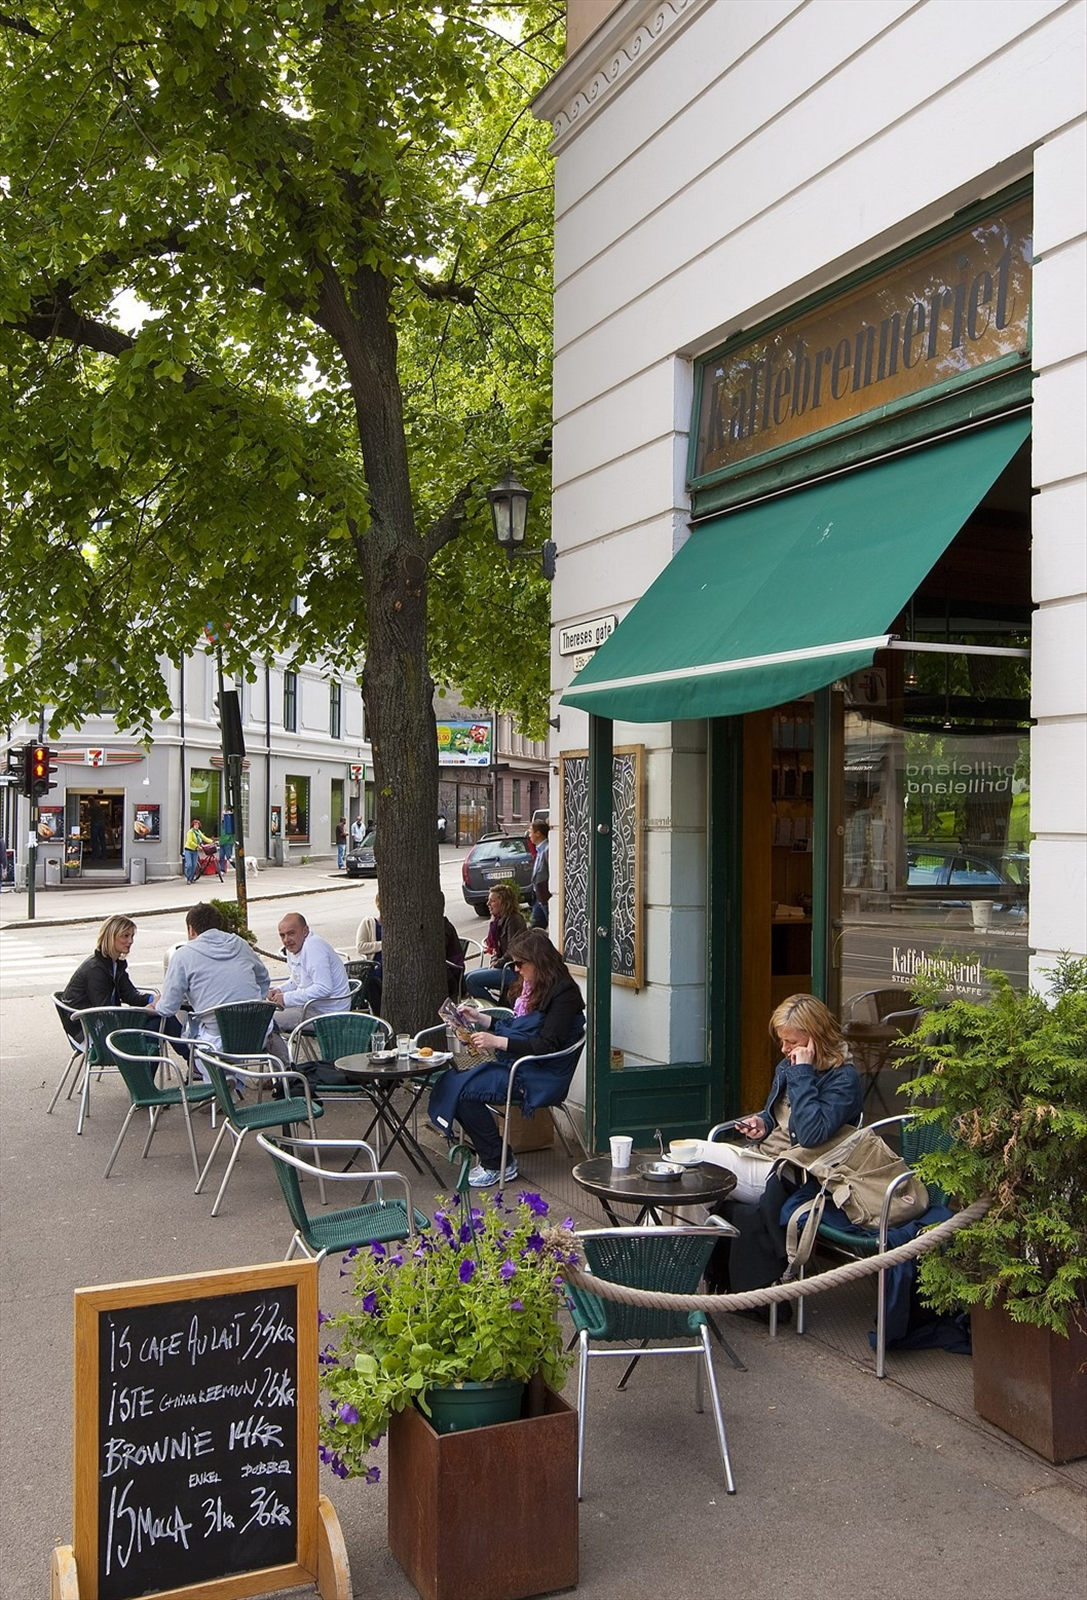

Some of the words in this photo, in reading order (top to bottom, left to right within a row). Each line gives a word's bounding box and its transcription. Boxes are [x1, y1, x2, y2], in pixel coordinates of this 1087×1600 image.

[706, 233, 1016, 455] Kaffebrenneriet
[562, 630, 592, 648] Thereses
[595, 622, 612, 645] gate
[956, 985, 982, 996] KAFFE
[139, 1332, 184, 1366] CAFE
[189, 1471, 222, 1488] ENKEL
